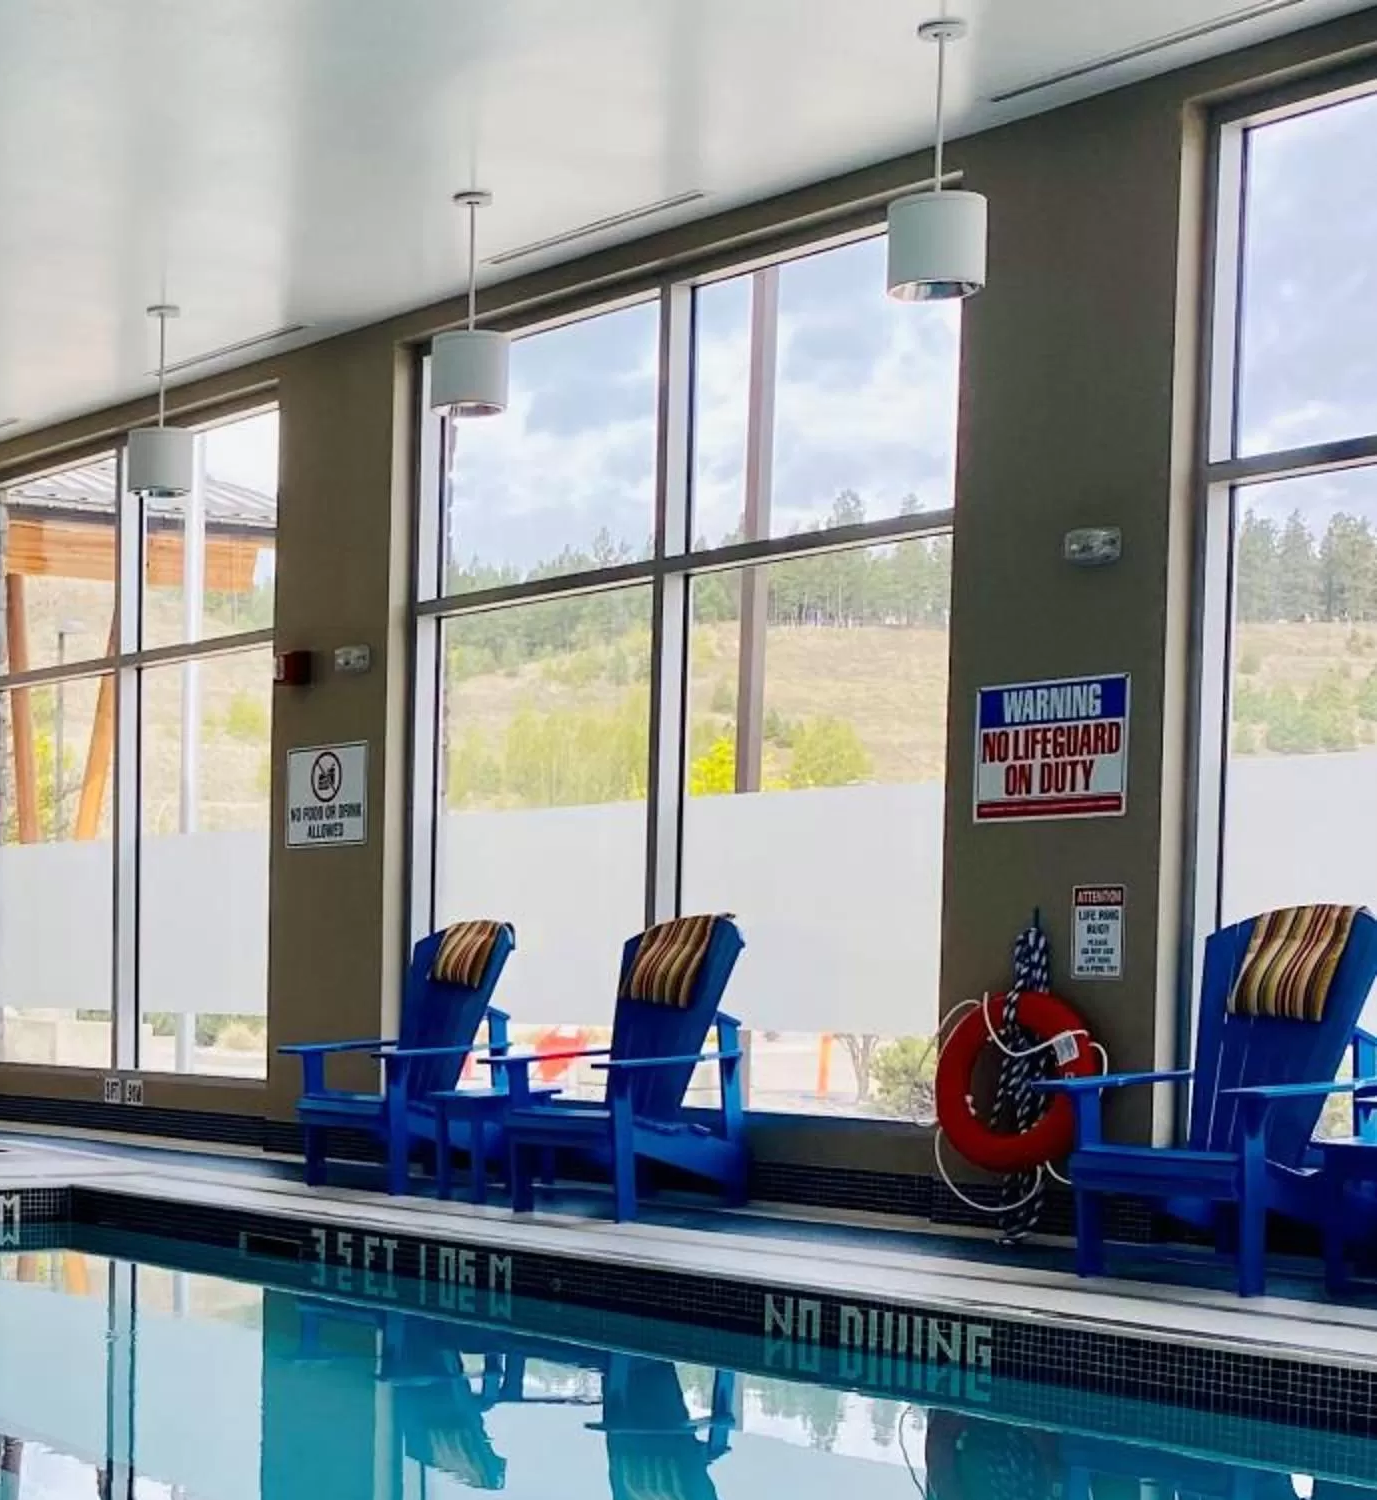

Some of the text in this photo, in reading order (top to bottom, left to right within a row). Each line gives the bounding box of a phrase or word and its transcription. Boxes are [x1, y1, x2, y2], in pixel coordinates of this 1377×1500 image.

[1003, 683, 1102, 723] WARNING
[982, 722, 1121, 763] NO LIFEGUARD
[1005, 759, 1095, 796] ON DUTY
[291, 803, 361, 822] NO FOOD OR DRINK
[308, 822, 344, 838] ALLOWED
[765, 1293, 821, 1341] NO
